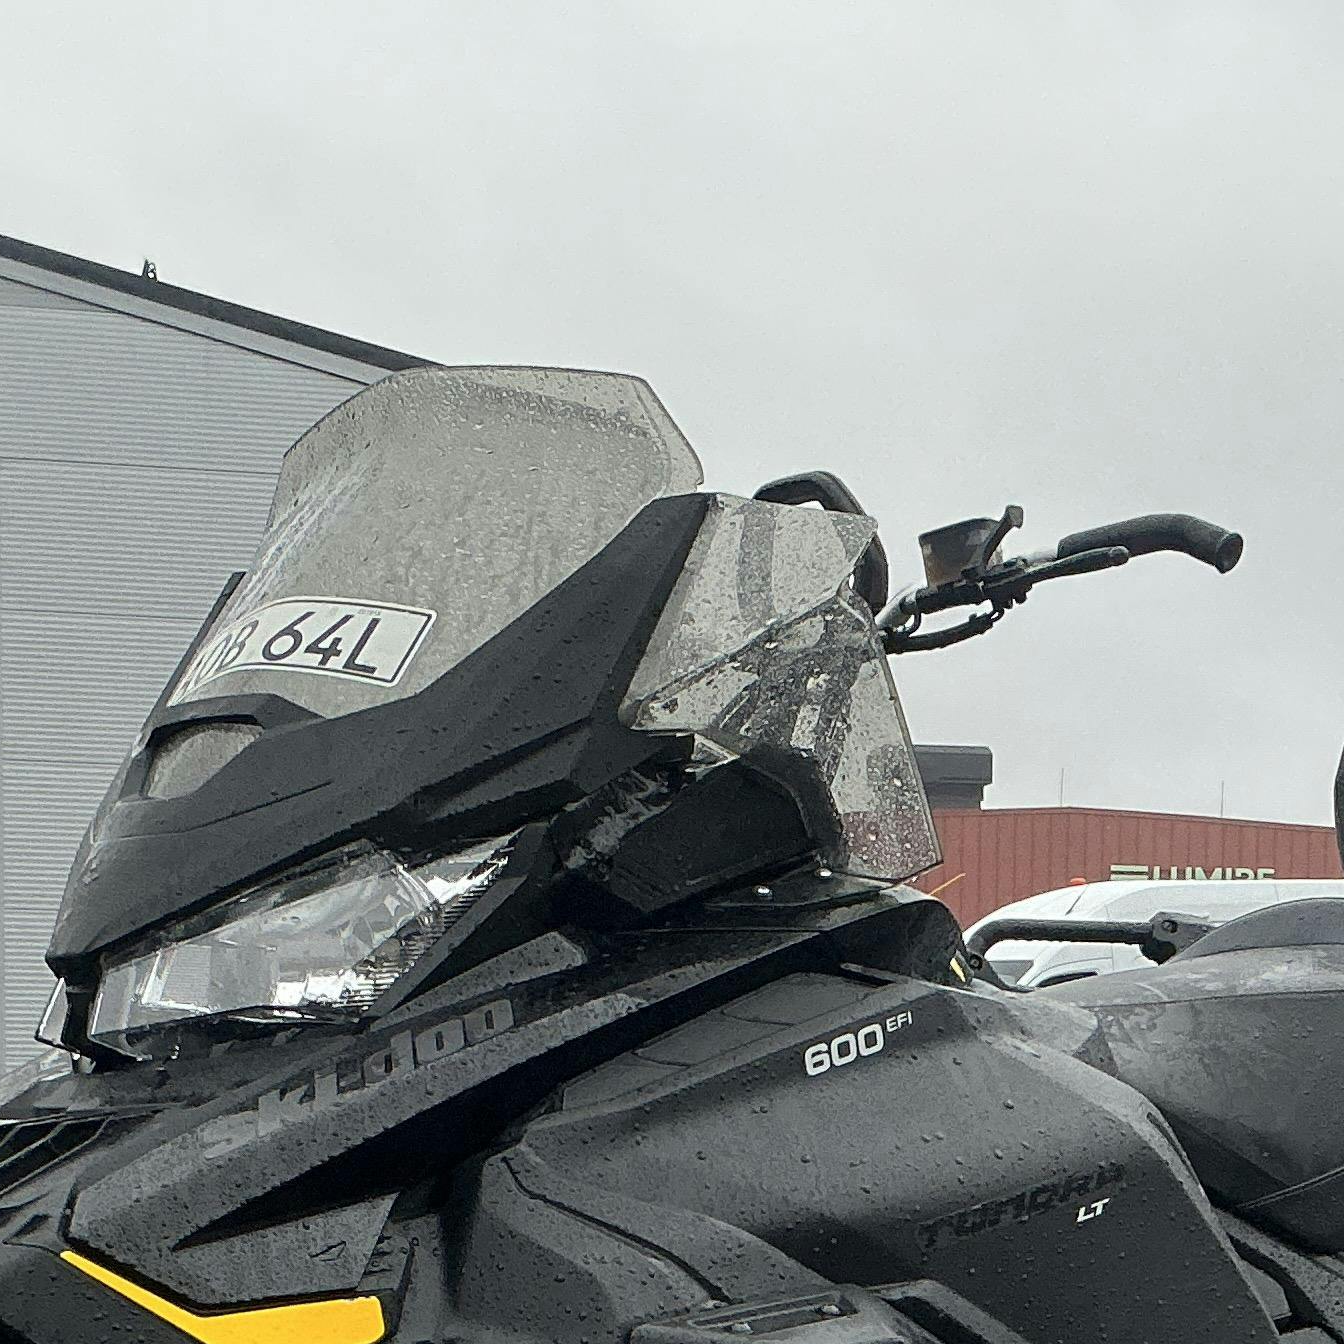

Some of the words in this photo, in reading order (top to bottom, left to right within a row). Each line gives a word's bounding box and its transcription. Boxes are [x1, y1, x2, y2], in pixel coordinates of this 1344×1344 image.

[262, 611, 381, 674] 64L
[805, 1023, 884, 1076] 600
[886, 1010, 913, 1033] EFI
[1076, 1197, 1111, 1222] LT
